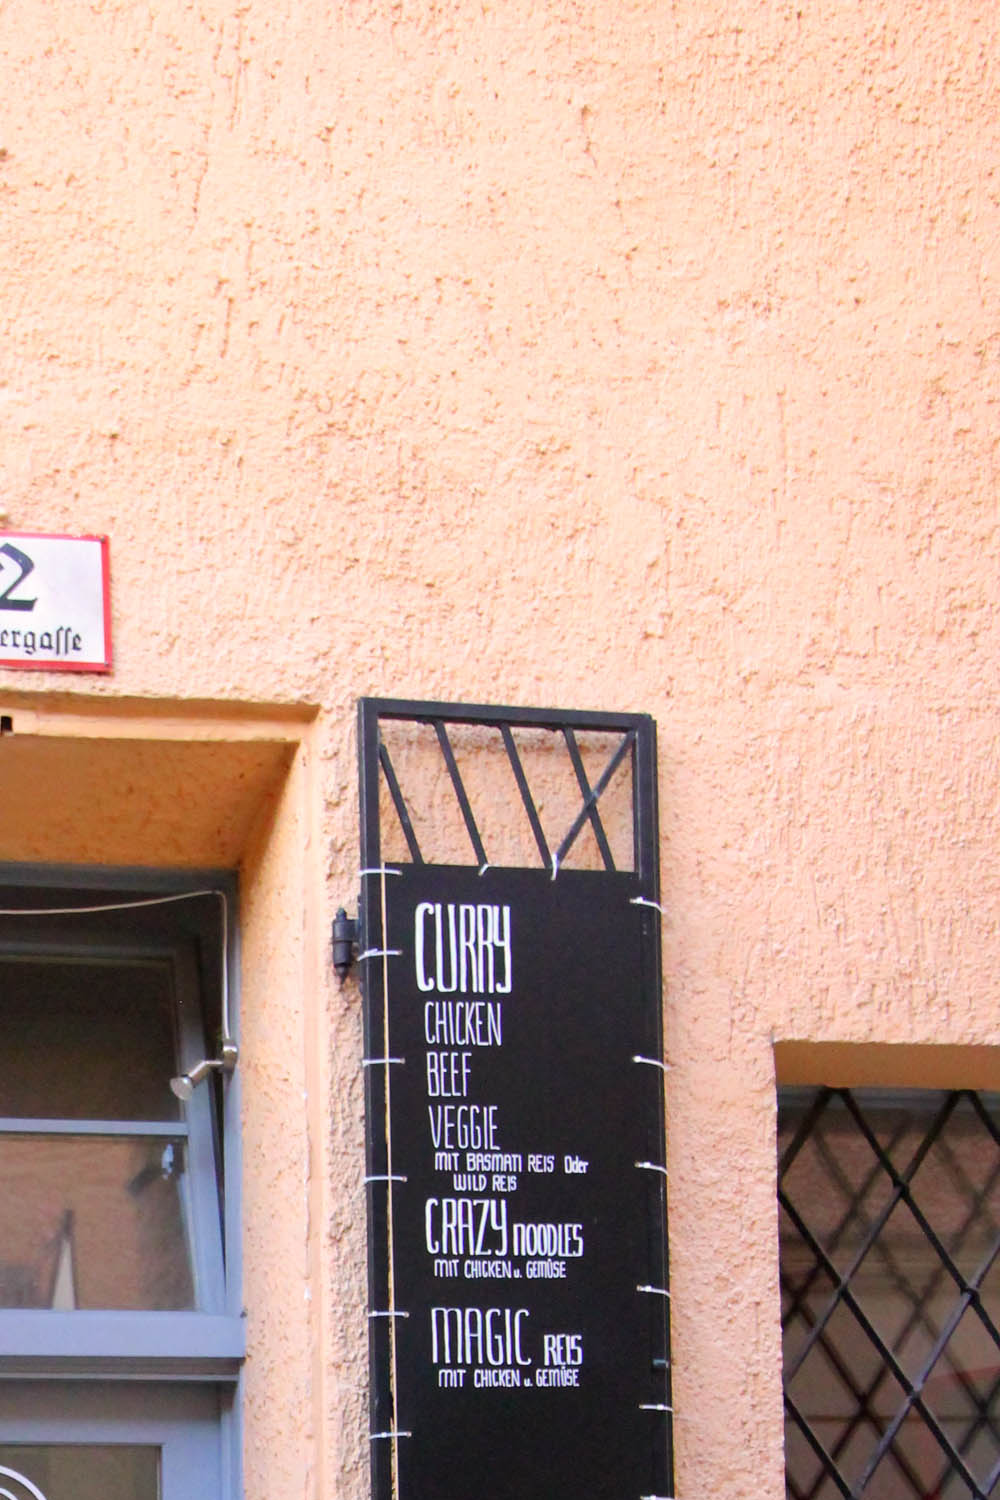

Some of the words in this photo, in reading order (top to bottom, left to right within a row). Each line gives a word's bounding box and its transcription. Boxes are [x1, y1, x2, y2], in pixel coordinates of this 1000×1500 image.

[415, 902, 512, 993] CURRY
[424, 1001, 502, 1046] CHICKEN
[426, 1052, 472, 1097] BEEF
[428, 1104, 501, 1150] VEGGIE
[434, 1152, 459, 1172] MIT
[466, 1152, 522, 1173] BASMATI
[527, 1154, 555, 1173] REIS
[453, 1173, 487, 1192] WILD
[492, 1174, 518, 1192] REIS
[424, 1198, 508, 1257] CRAZY
[512, 1223, 584, 1257] NOODLES
[434, 1259, 459, 1278] MIT
[464, 1259, 512, 1279] CHICKEN
[526, 1258, 567, 1279] GEMÜSE
[431, 1307, 532, 1366] MAGIC
[543, 1333, 583, 1366] REIS
[438, 1368, 466, 1388] MIT
[474, 1368, 521, 1388] CHICKEN
[535, 1366, 580, 1388] GEMÜSE
